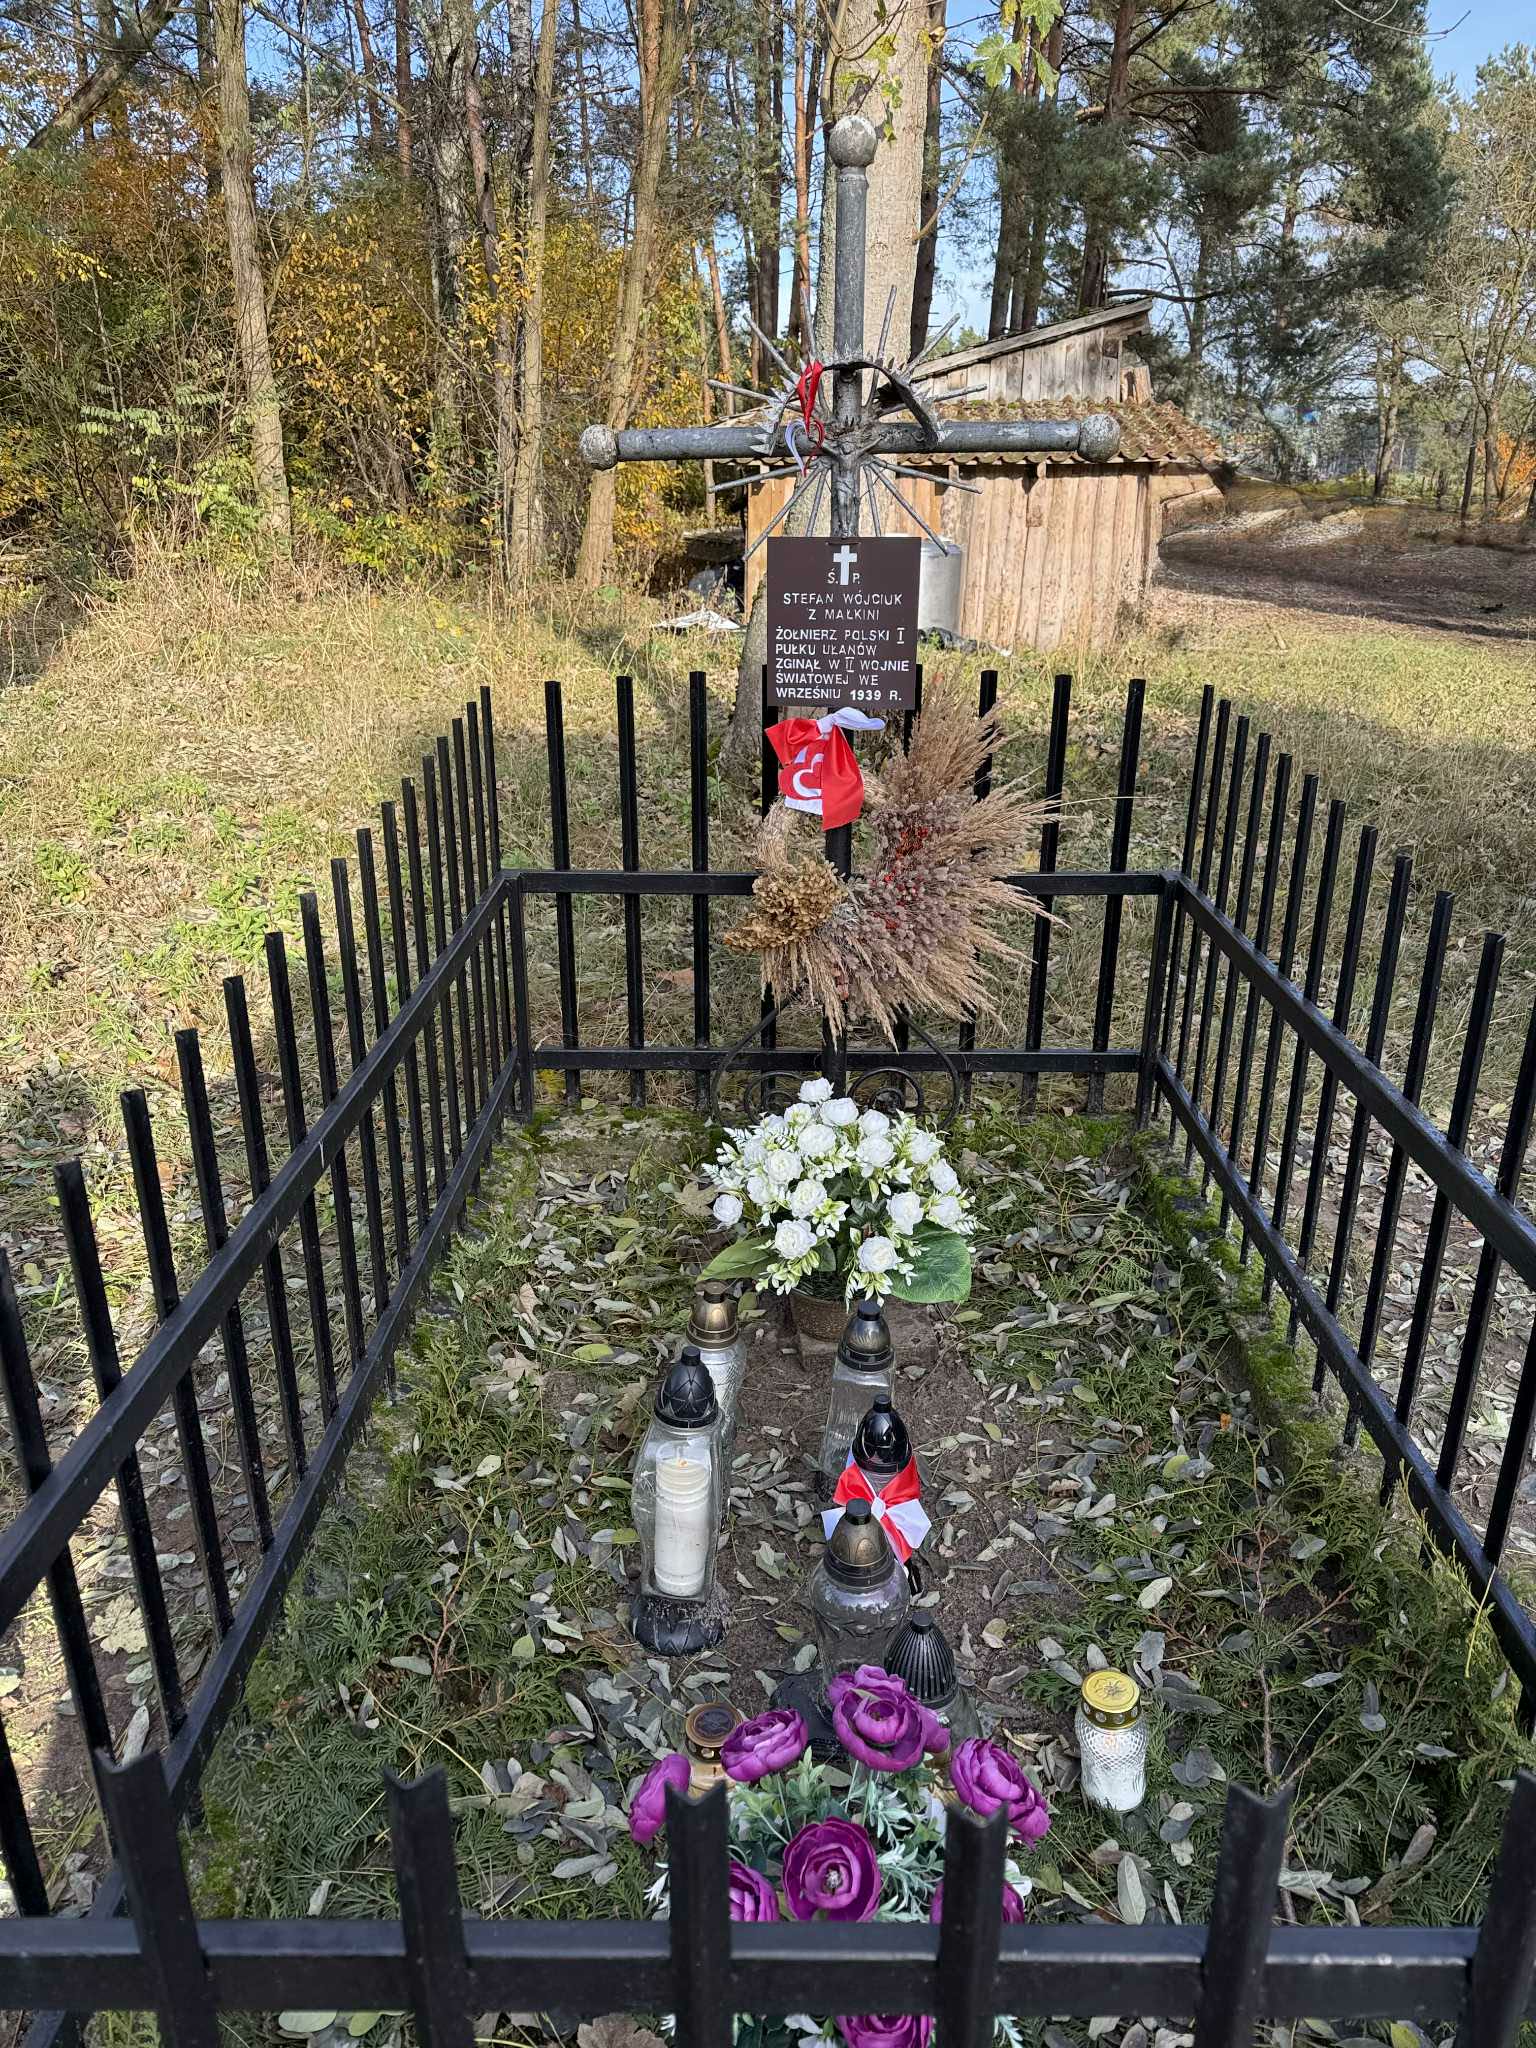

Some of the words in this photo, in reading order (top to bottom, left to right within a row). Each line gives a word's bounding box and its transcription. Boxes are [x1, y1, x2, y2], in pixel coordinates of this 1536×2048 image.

[827, 567, 839, 585] Ś.
[783, 593, 834, 605] STEFAN
[842, 589, 903, 606] WÓJCIUK
[808, 608, 817, 621] Z
[824, 608, 880, 621] MAŁKINI
[775, 625, 838, 641] ŻOŁNIERZ
[844, 629, 890, 642] POLSKI
[896, 627, 905, 645] I
[775, 643, 816, 656] PUŁKU
[822, 641, 877, 657] UŁANÓW
[775, 657, 822, 673] ZGINĄŁ
[828, 659, 841, 670] W
[844, 656, 855, 673] II
[859, 659, 910, 672] WOJNIE
[775, 669, 849, 686] ŚWIATOWEJ
[858, 673, 879, 686] WE
[775, 685, 841, 699] WRZEŚNIU
[849, 689, 882, 701] 1939
[889, 689, 902, 701] R.
